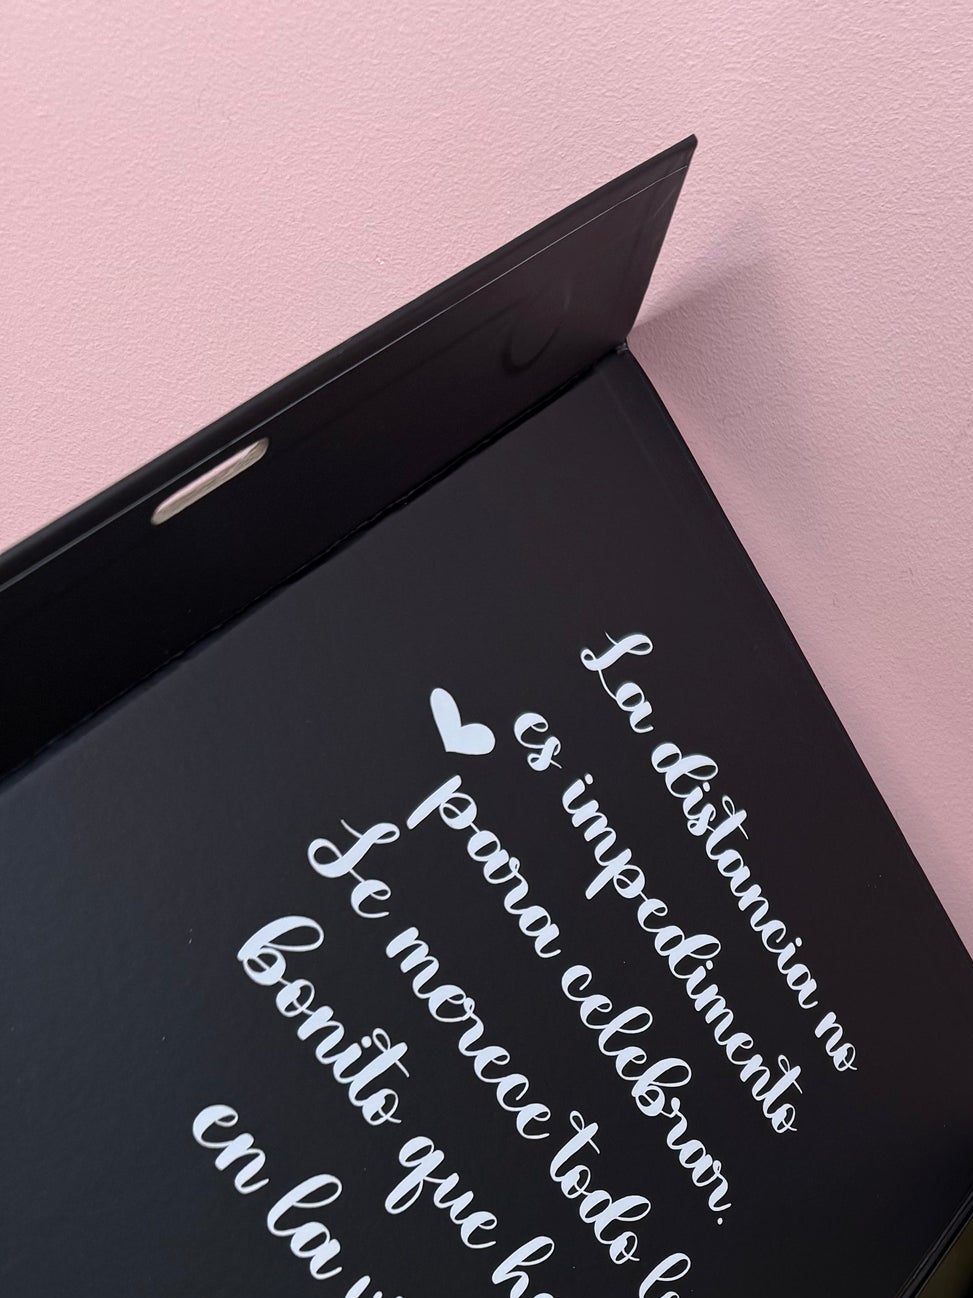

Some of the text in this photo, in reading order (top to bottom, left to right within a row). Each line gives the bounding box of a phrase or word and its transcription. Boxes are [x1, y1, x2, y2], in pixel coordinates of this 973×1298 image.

[308, 819, 400, 919] Se
[386, 926, 550, 1140] merece
[549, 1110, 651, 1265] todo
[407, 775, 732, 1225] para celebrar.
[514, 713, 802, 1134] es impedimento
[581, 633, 857, 1072] La distancia no
[192, 1104, 269, 1194] en
[267, 1174, 342, 1280] la
[237, 915, 410, 1126] bonito
[385, 1136, 497, 1249] que
